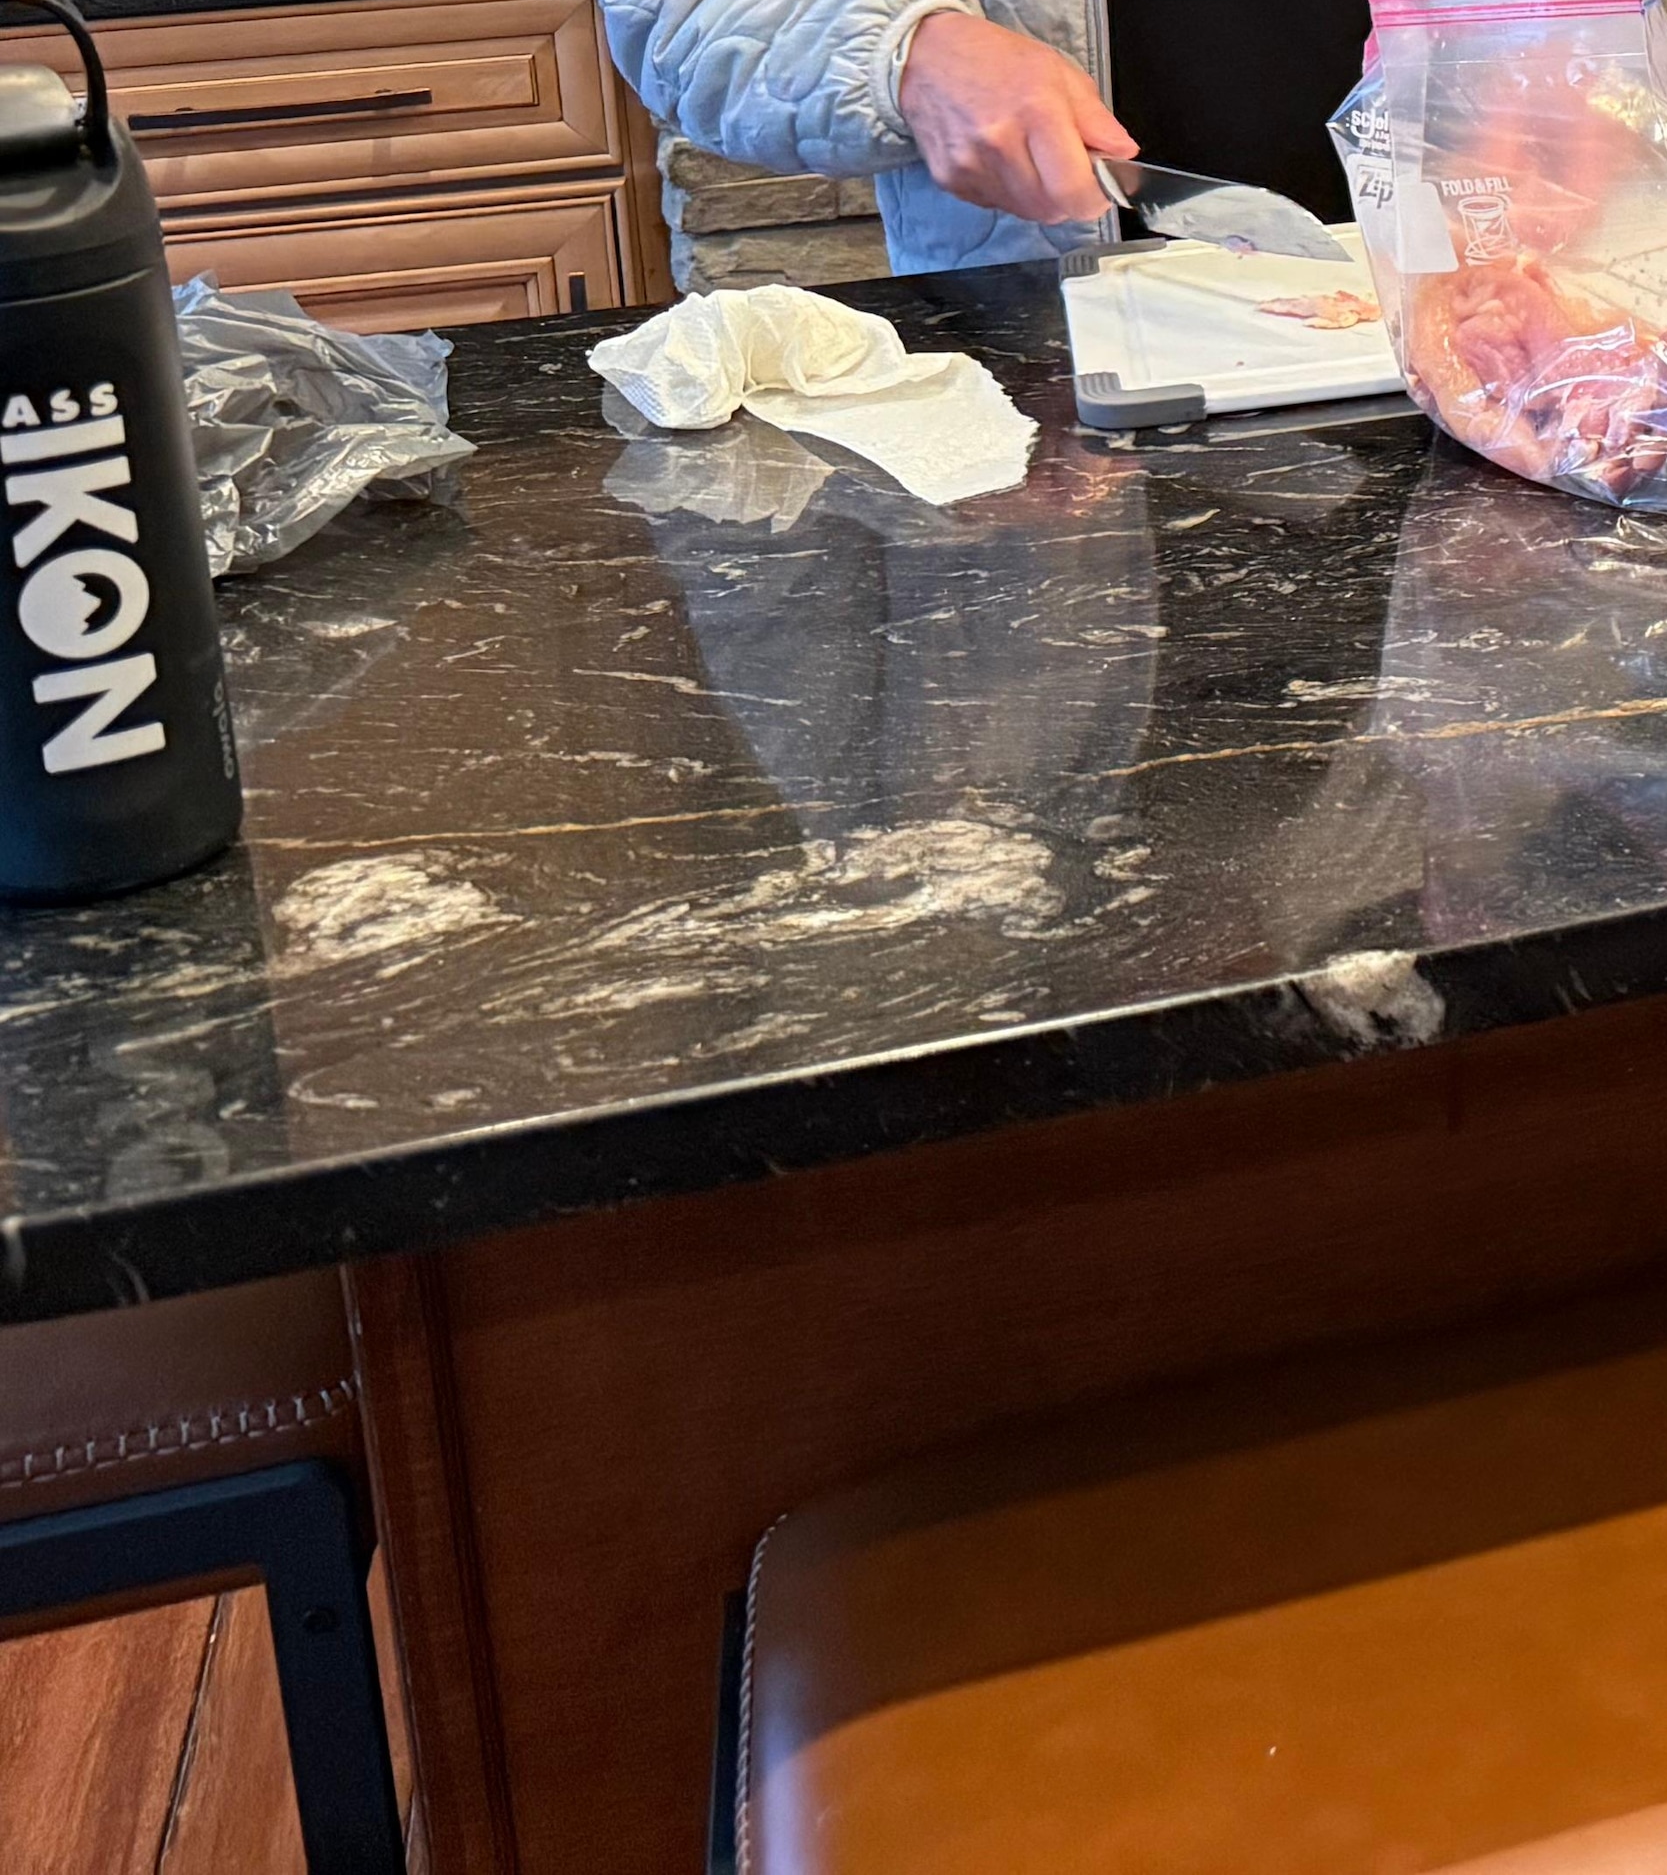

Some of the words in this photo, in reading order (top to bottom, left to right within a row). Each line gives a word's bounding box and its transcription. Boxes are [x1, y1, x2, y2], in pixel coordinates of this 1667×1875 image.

[1358, 169, 1395, 210] Zip
[1441, 179, 1474, 197] FOLD
[1474, 178, 1486, 194] &
[1486, 175, 1513, 193] FILL
[1, 380, 119, 426] ASS
[0, 414, 167, 775] IKON
